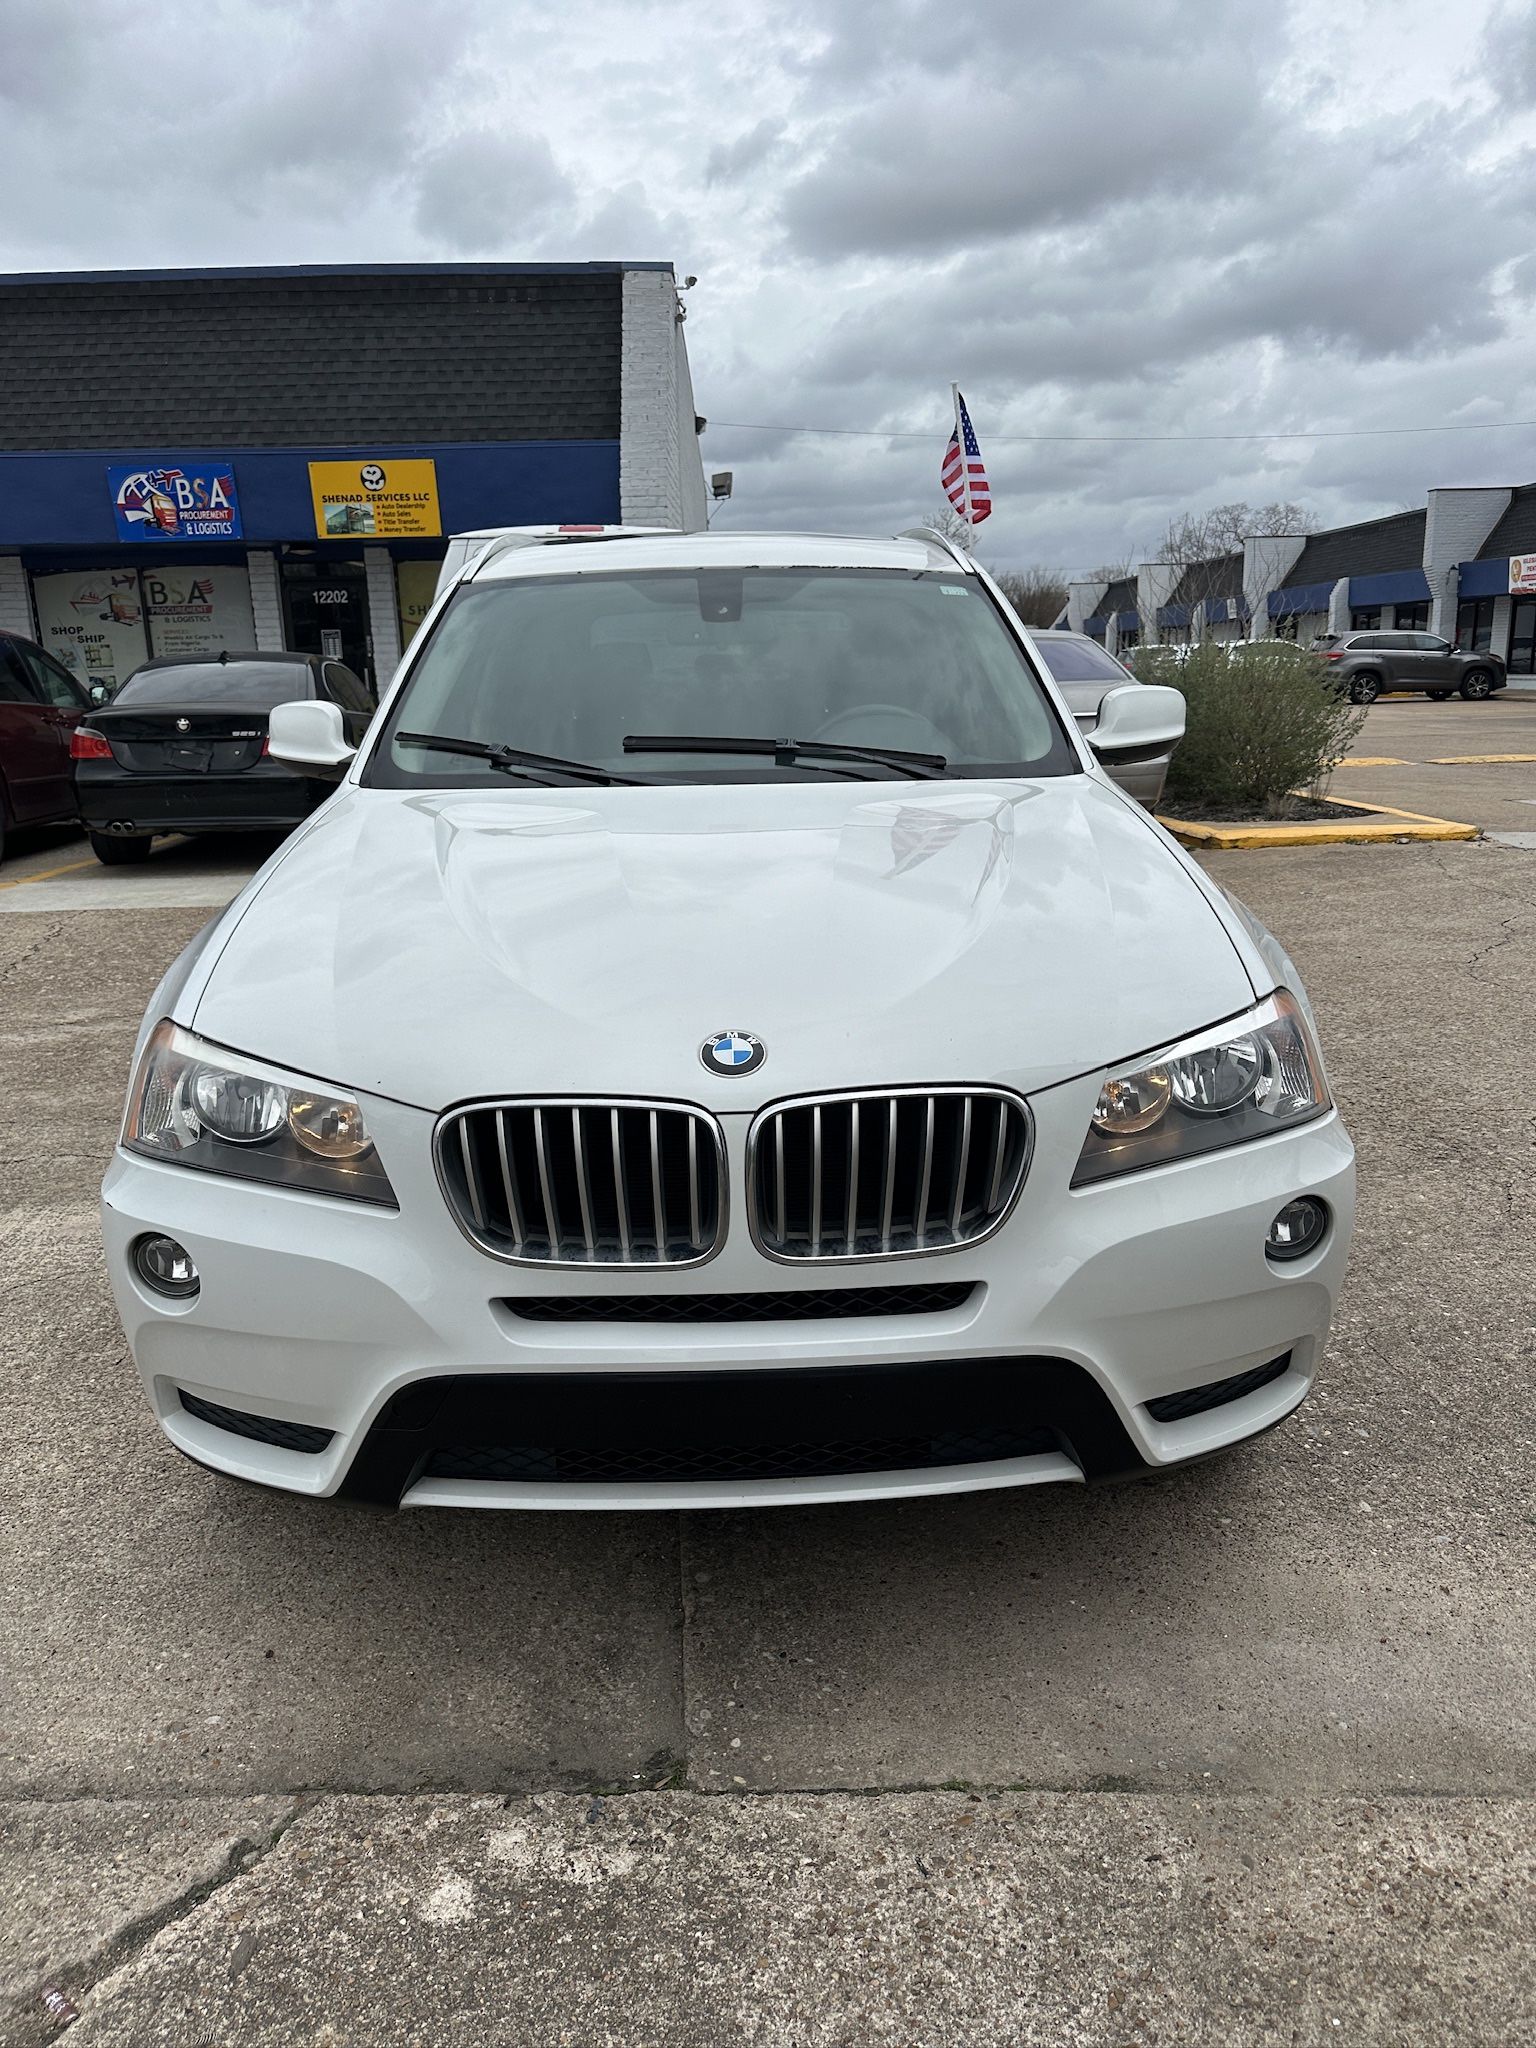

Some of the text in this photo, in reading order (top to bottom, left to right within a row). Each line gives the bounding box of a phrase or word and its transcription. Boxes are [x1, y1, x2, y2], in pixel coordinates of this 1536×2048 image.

[175, 477, 230, 509] BSA
[322, 493, 430, 503] SHENAD SERVICES LLC
[179, 510, 229, 520] PROCUREMENT
[186, 522, 233, 535] & LOGISTICS
[150, 580, 208, 605] BSA
[312, 590, 349, 604] 12202
[150, 606, 208, 615] PROCUREMENT
[408, 605, 428, 616] SH
[172, 616, 211, 624] LOGISTICS
[51, 626, 84, 635] SHOP
[77, 634, 105, 644] SHIP
[706, 1031, 760, 1046] BMW
